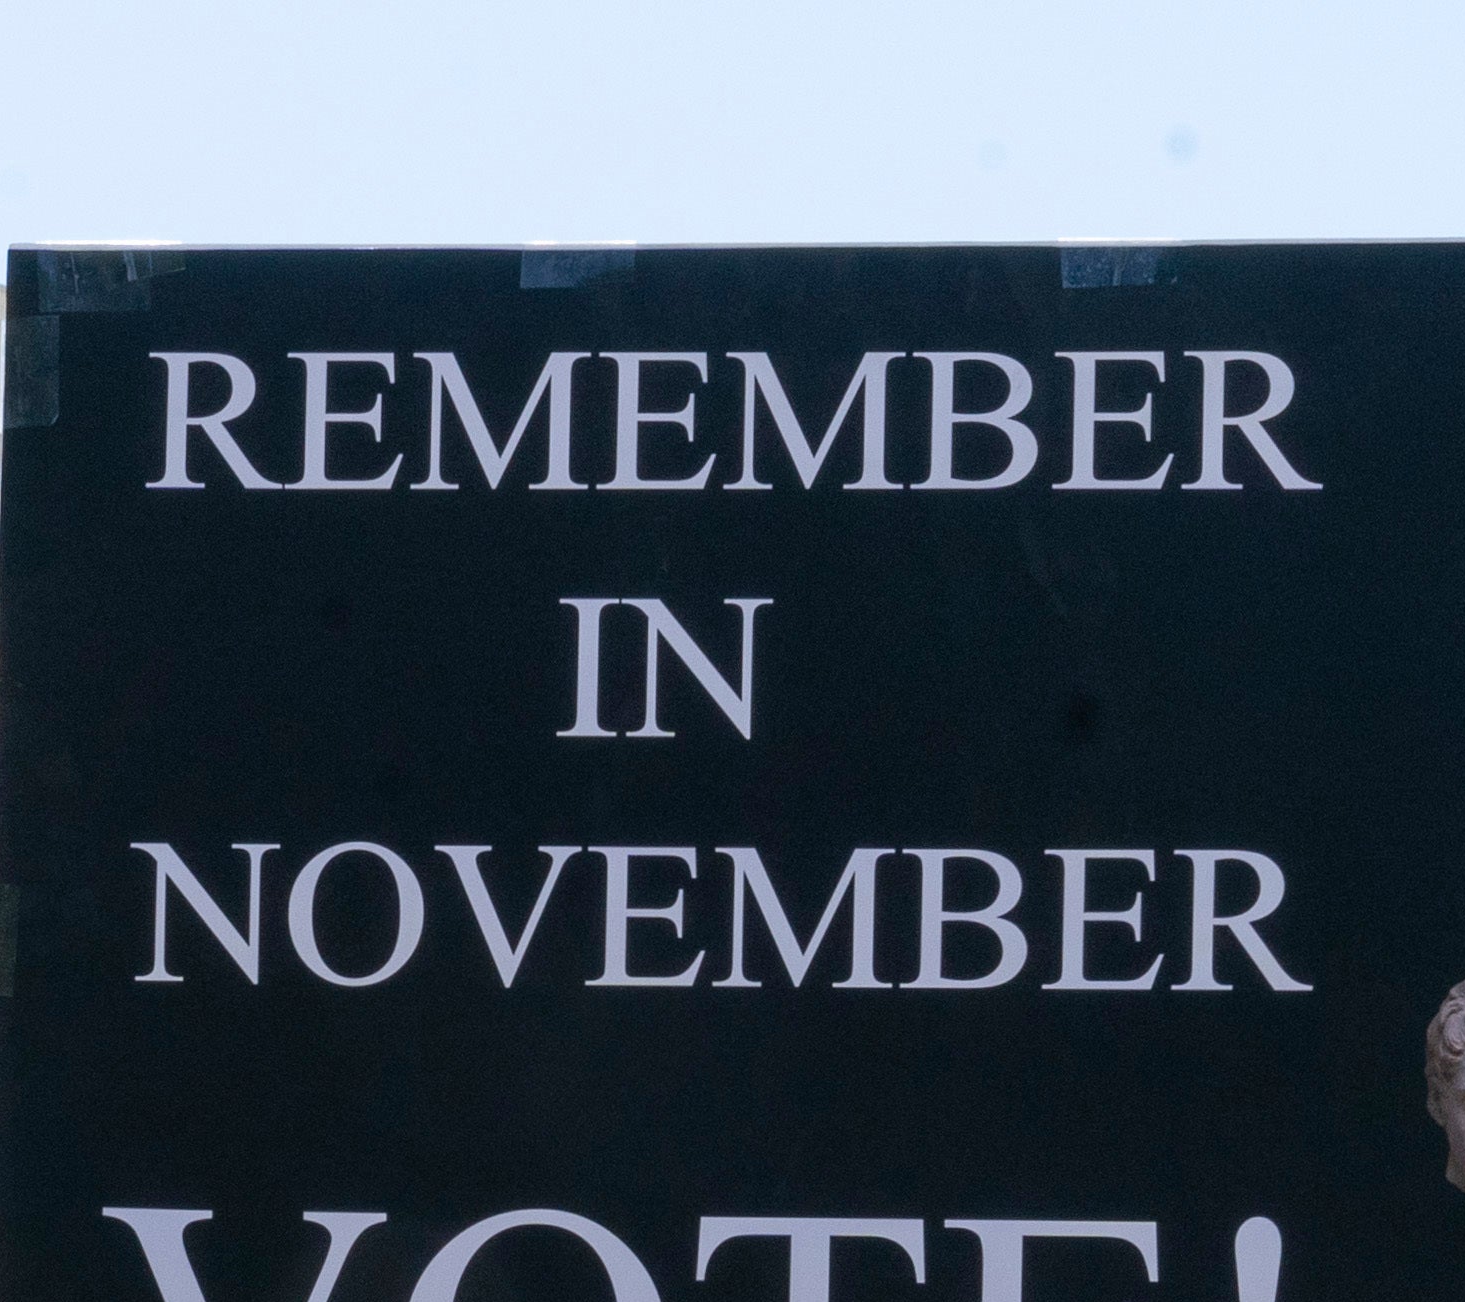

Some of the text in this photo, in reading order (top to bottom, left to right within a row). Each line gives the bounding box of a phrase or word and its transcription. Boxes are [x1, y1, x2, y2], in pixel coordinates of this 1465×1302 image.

[145, 350, 1324, 491] REMEMBER
[556, 597, 774, 741] IN
[130, 841, 1314, 991] NOVEMBER
